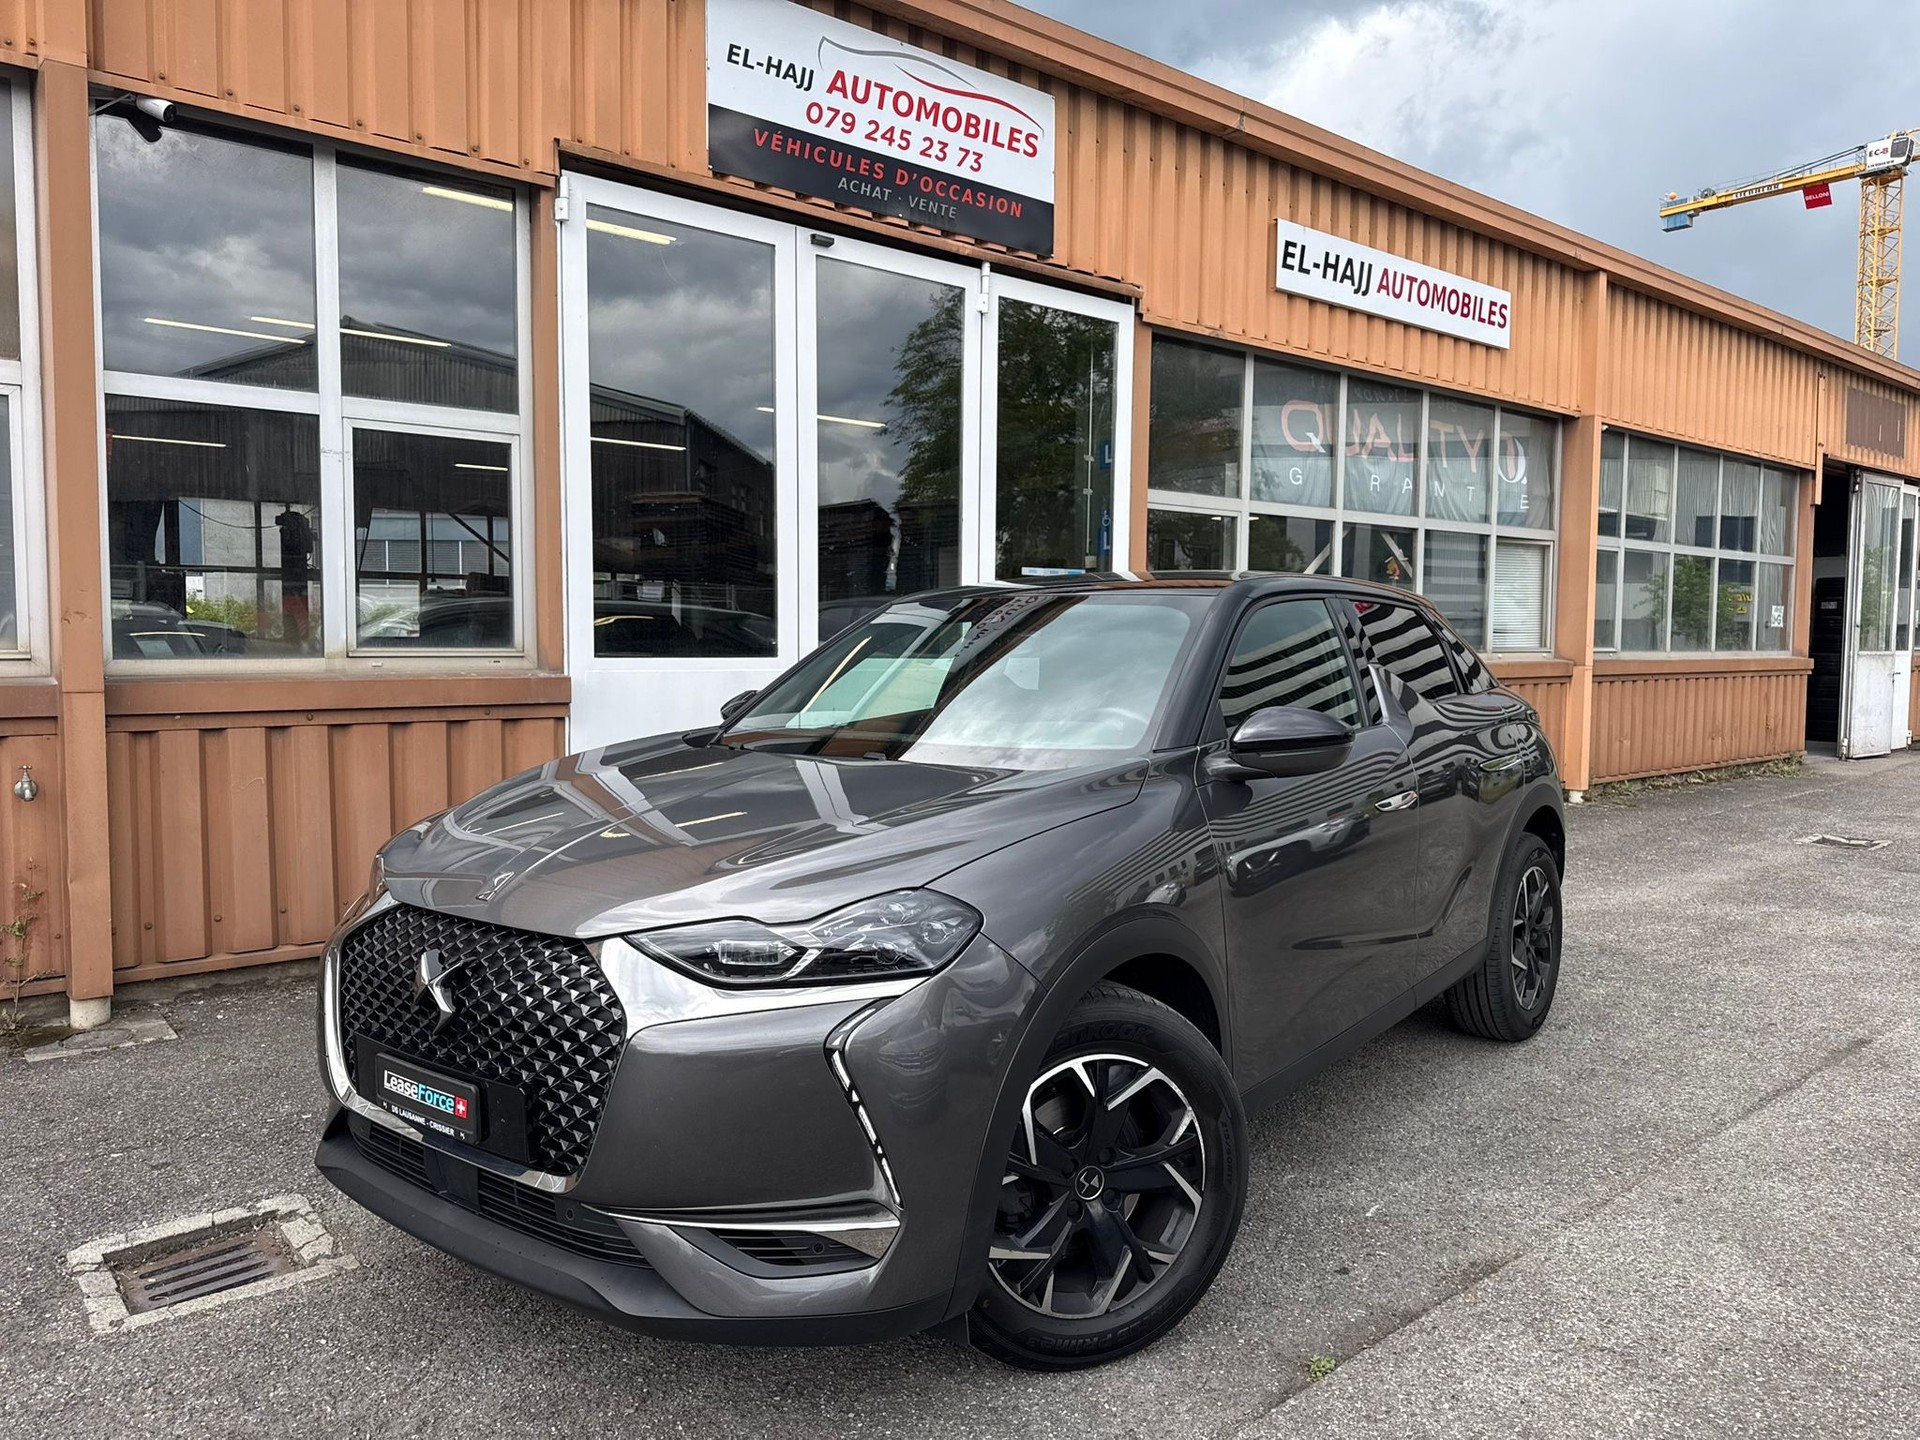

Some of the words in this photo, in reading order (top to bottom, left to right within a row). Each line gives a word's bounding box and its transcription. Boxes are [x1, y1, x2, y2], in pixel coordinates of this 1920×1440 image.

[726, 42, 815, 92] EL-HAJJ
[825, 69, 1039, 158] AUTOMOBILES
[753, 127, 886, 180] VÉHICULES
[895, 167, 1023, 218] D'OCCASION
[805, 101, 857, 134] 079
[864, 119, 912, 151] 245
[919, 136, 949, 163] 23
[955, 146, 984, 173] 73
[837, 176, 892, 202] ACHAT
[908, 194, 958, 219] VENTE
[1281, 239, 1373, 297] EL-HAJJ
[1376, 267, 1508, 329] AUTOMOBILES
[1281, 400, 1486, 474] QUALTY
[1288, 467, 1530, 511] GRANTE
[384, 1069, 455, 1112] LeaseForce
